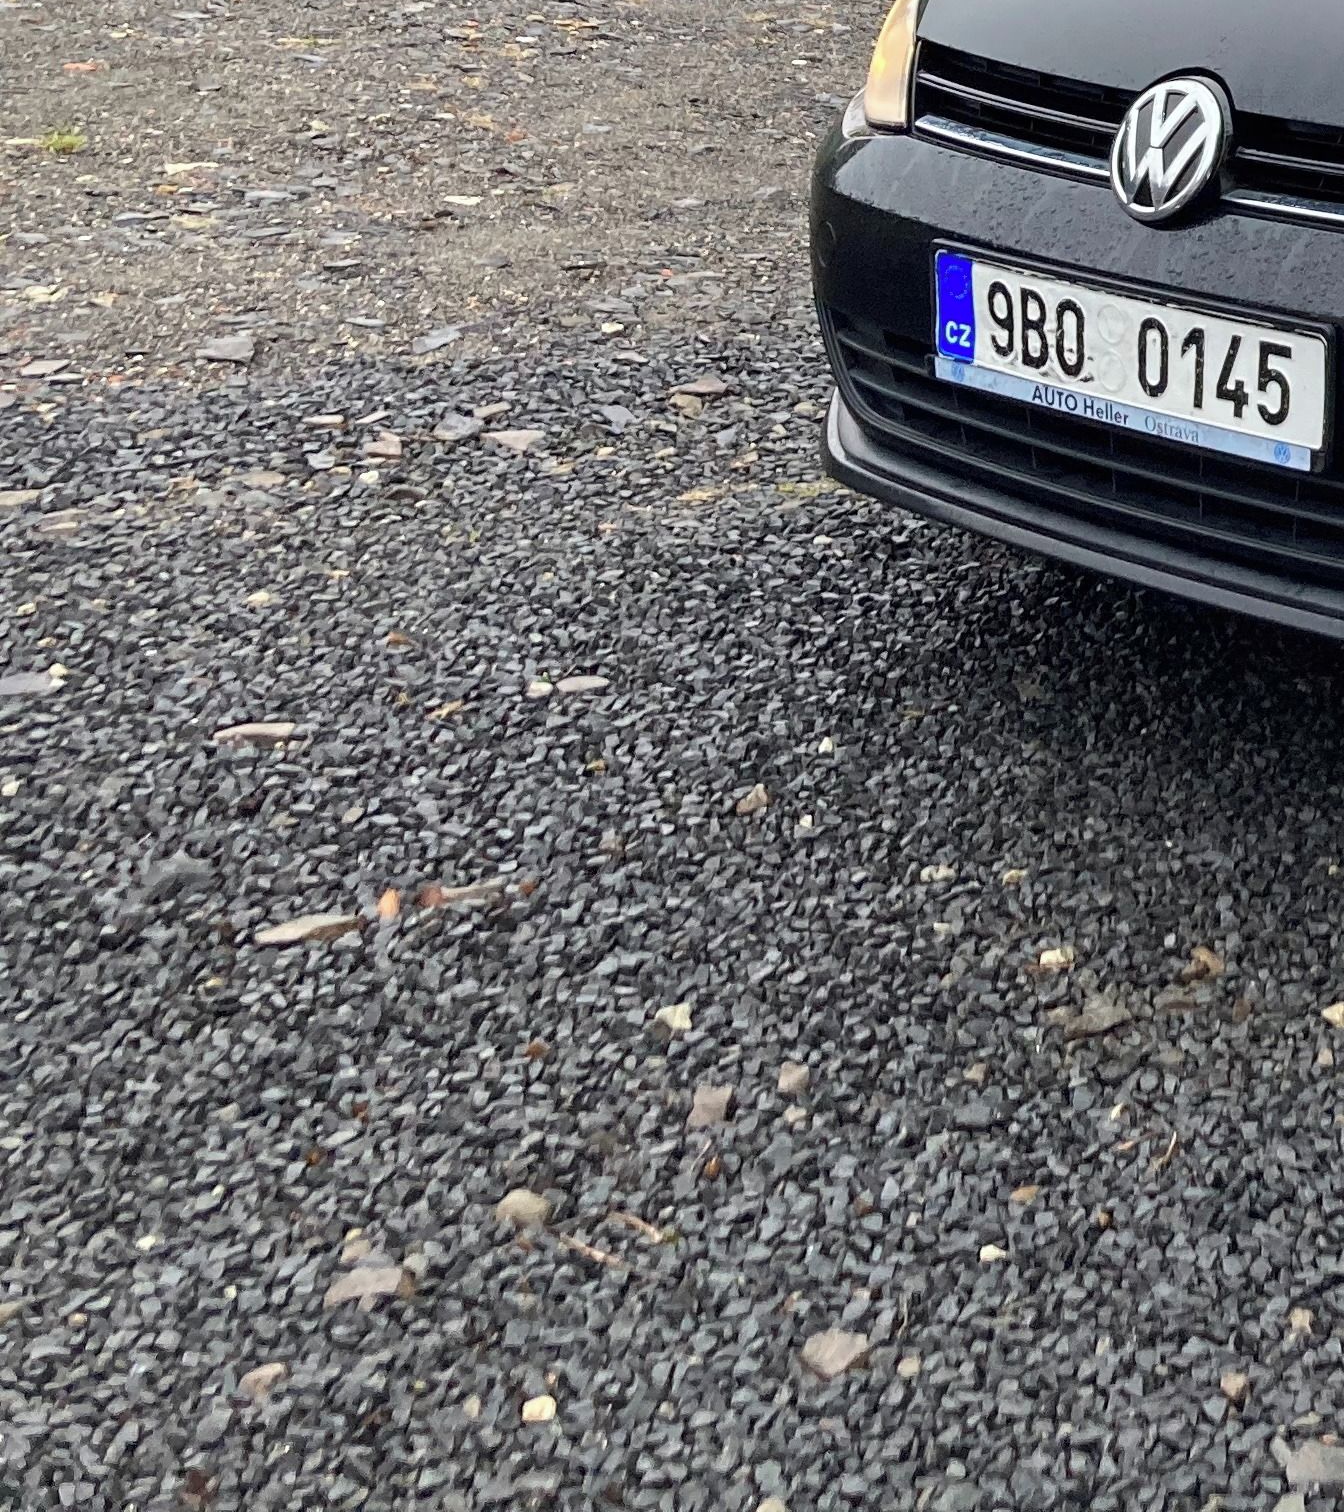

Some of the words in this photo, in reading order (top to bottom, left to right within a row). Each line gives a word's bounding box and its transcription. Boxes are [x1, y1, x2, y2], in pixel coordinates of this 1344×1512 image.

[945, 320, 972, 348] CZ
[1137, 317, 1293, 426] 0145
[1032, 386, 1079, 412] AUTO
[1083, 396, 1129, 426] Heller
[1144, 415, 1200, 445] Ostrava
